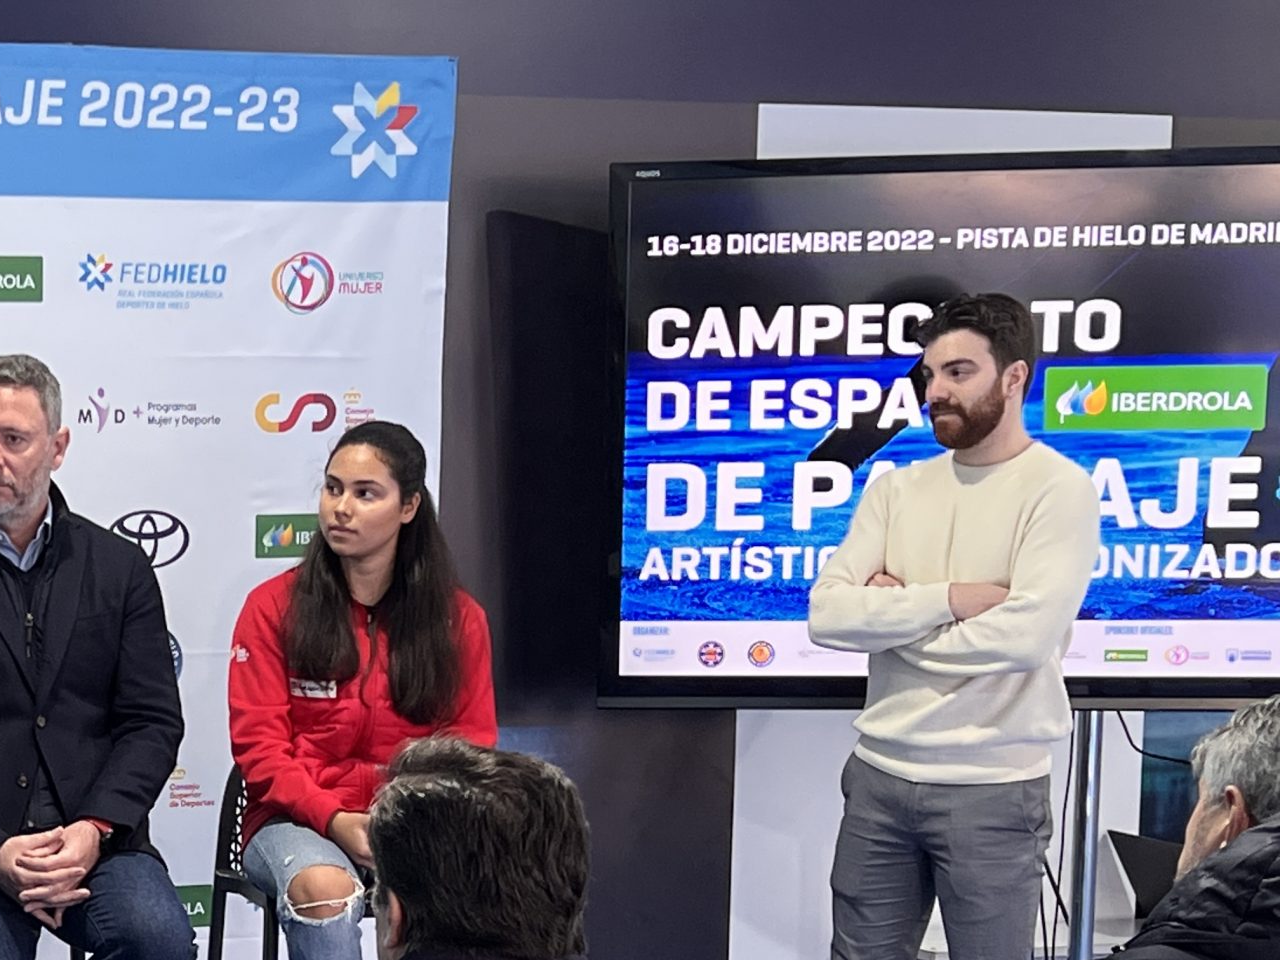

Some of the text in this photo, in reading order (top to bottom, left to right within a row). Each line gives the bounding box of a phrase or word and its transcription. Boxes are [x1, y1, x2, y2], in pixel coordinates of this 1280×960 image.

[78, 80, 300, 134] 2022-23
[646, 233, 723, 257] 16-18
[726, 230, 863, 255] DICIEMBRE
[866, 229, 935, 252] 2022
[956, 226, 1029, 250] PISTA
[1033, 225, 1068, 248] DE
[1072, 223, 1147, 248] HIELO
[1150, 223, 1186, 246] DE
[119, 262, 228, 284] FEDHIELO
[338, 282, 383, 294] MUJER
[647, 298, 1122, 360] CAMPEOTO
[147, 401, 197, 413] Programas
[646, 376, 931, 432] DE ESPA
[1110, 389, 1254, 414] IBERDROLA
[147, 415, 173, 428] Mujer
[181, 415, 222, 428] Deporte
[645, 461, 766, 532] DE
